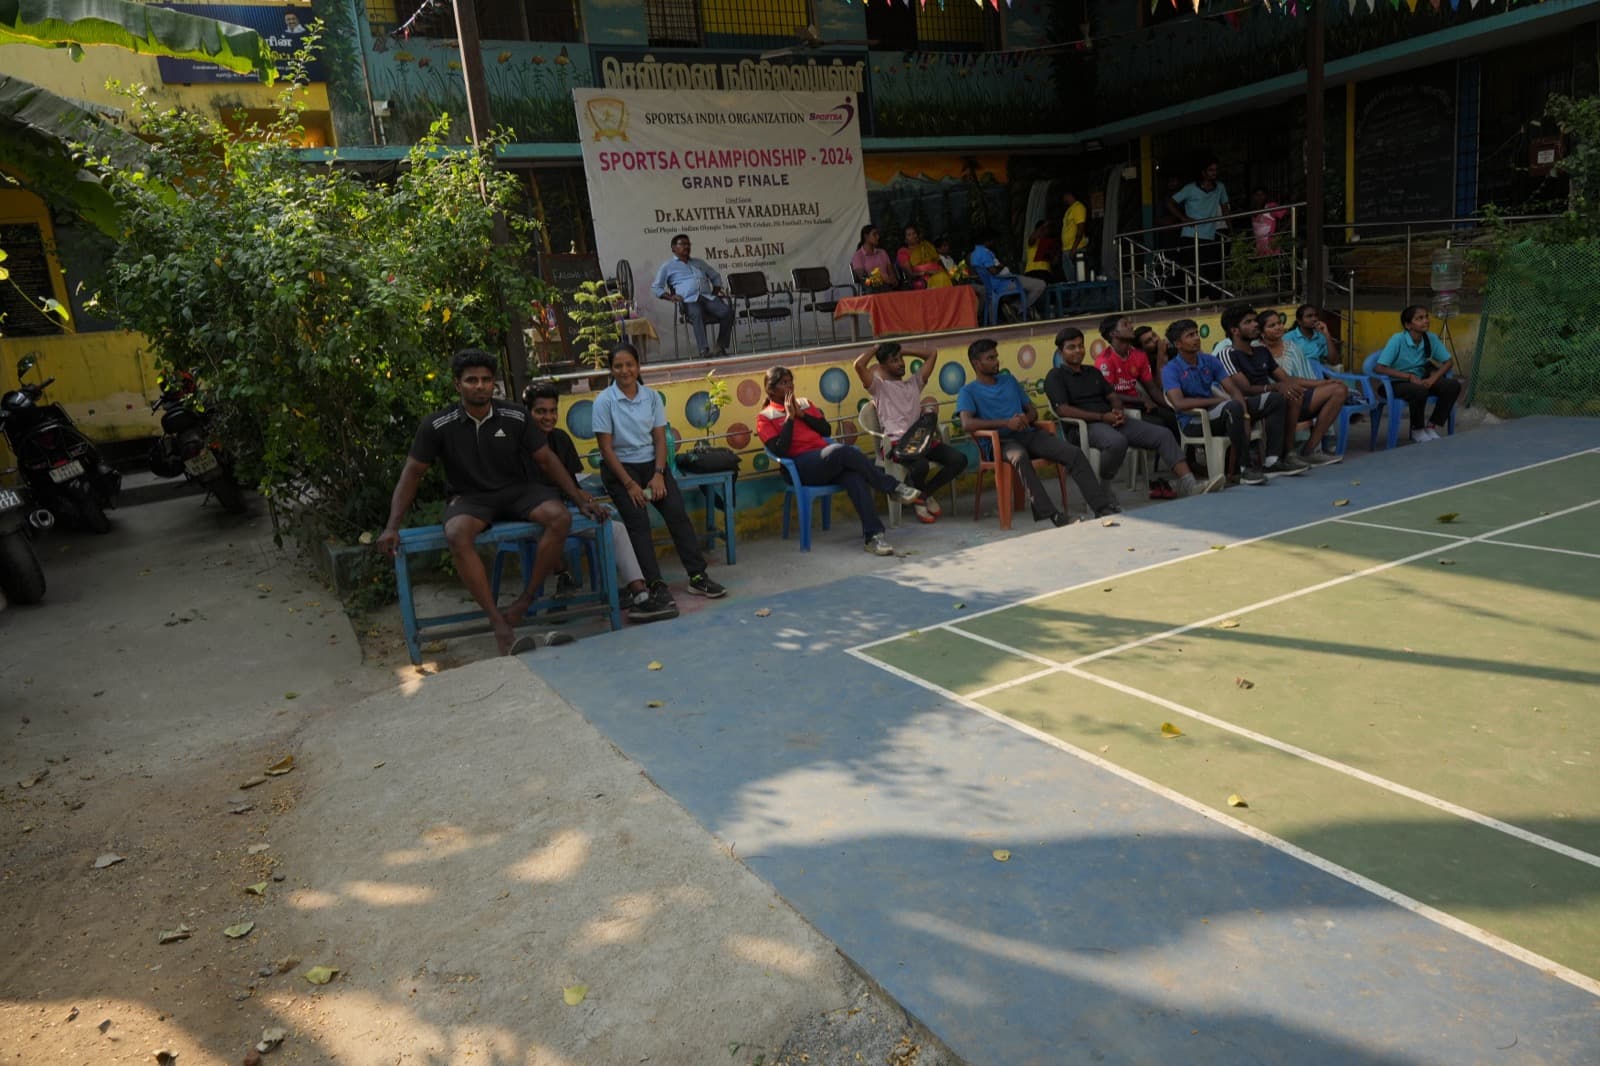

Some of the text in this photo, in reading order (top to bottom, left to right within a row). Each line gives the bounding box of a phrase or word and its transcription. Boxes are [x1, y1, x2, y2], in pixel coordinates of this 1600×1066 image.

[645, 112, 805, 125] SPORTSA INDIA ORGANIZATION
[599, 150, 681, 171] SPORTSA
[684, 149, 807, 170] CHAMPIONSHIP
[821, 147, 853, 165] 2024
[682, 174, 790, 190] GRAND FINALE
[655, 202, 820, 223] Dr.KAVITHA VARADHARAJ
[704, 242, 785, 261] Mrs.A.RAJINI
